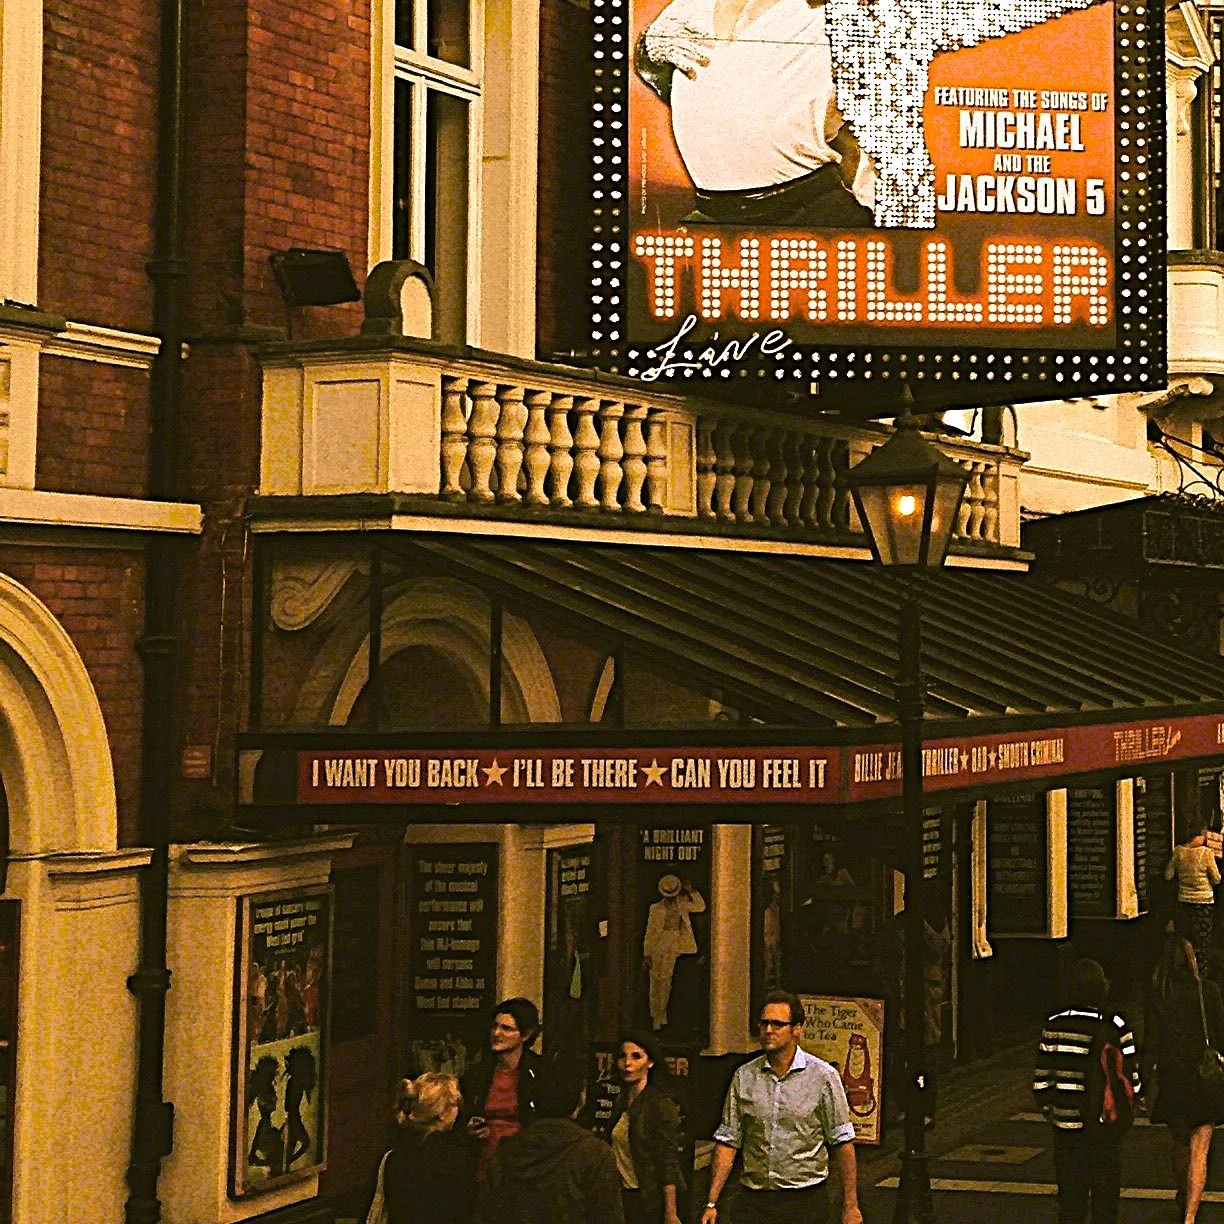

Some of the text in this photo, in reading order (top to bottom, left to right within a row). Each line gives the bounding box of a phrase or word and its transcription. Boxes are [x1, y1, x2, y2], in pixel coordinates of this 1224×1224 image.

[934, 86, 1108, 111] FEATURING THE SONGS OF
[959, 109, 1085, 151] MICHAEL
[993, 154, 1051, 173] AND THE
[937, 174, 1105, 215] JACKSON 5
[634, 233, 1109, 326] THRILLER
[640, 315, 798, 382] Live
[1113, 726, 1166, 761] THRILLER
[312, 758, 828, 788] I WANT YOU BACK I'LL BE THERE CAN YOU FEEL IT
[855, 752, 882, 783] BILLIE
[886, 751, 904, 780] JEA
[998, 742, 1029, 770] SMOOTH
[807, 1003, 858, 1019] The Tiger
[832, 1017, 864, 1031] Came
[804, 1030, 837, 1041] to Tea
